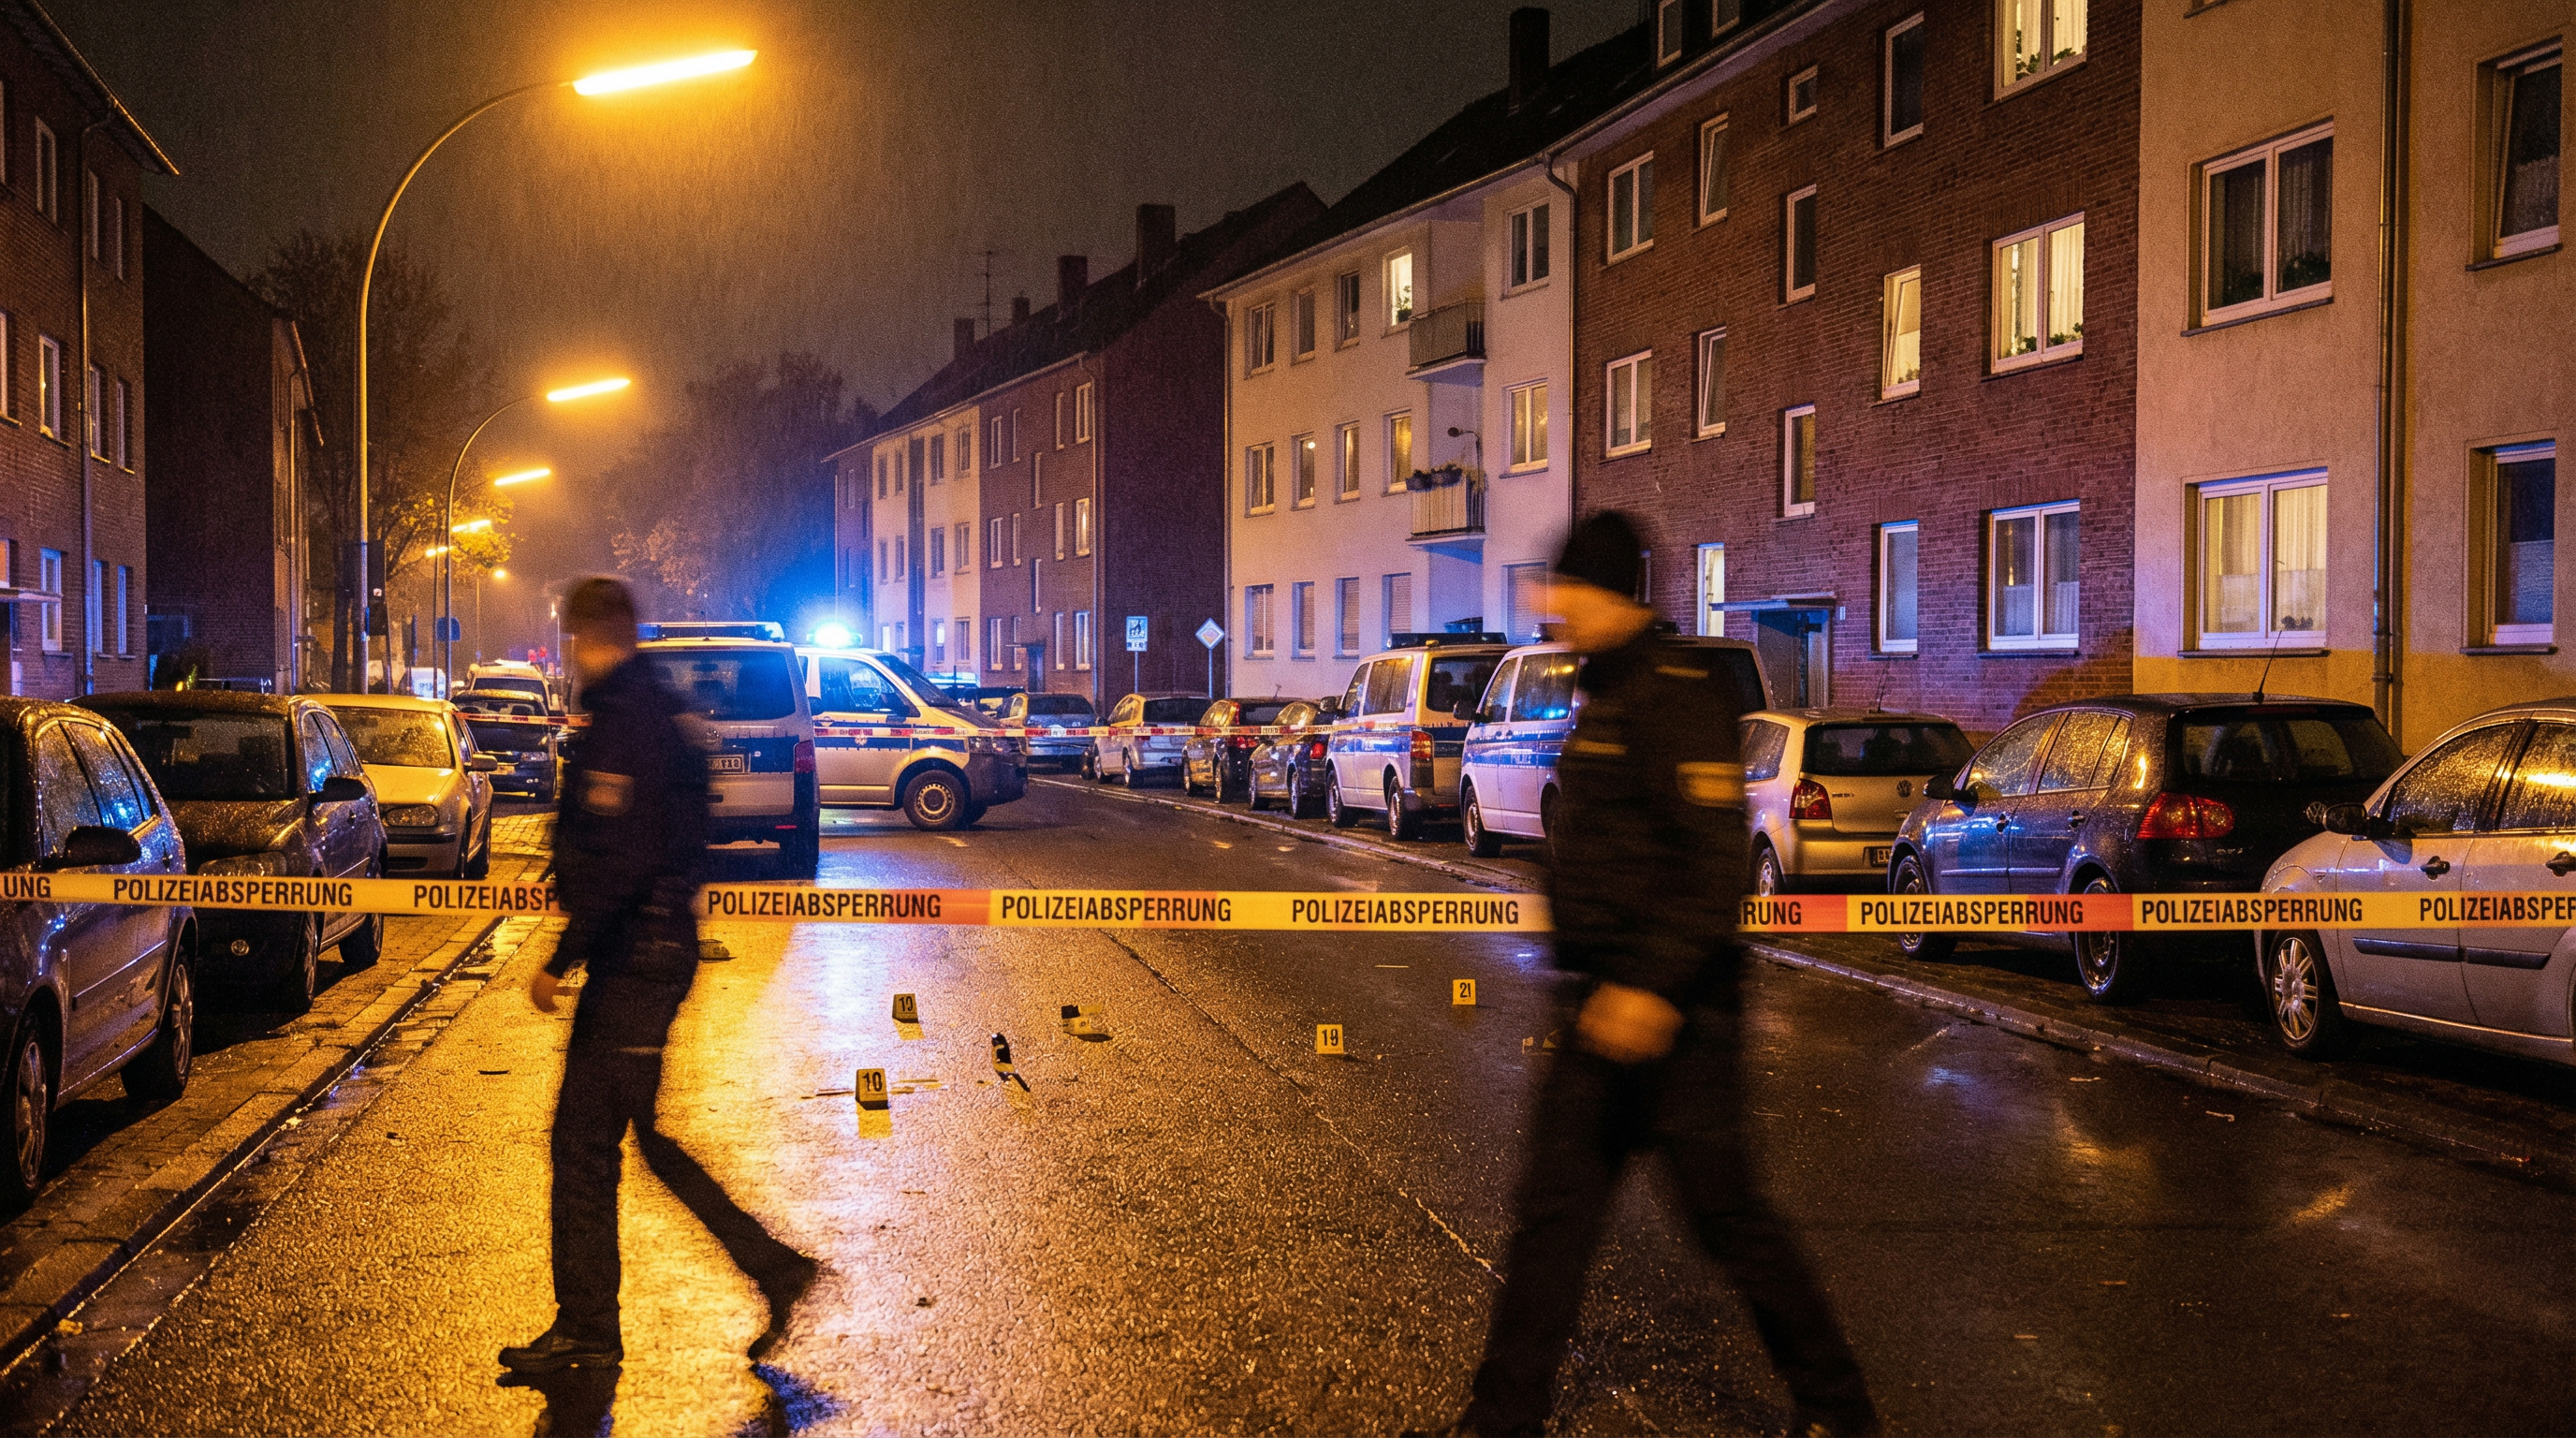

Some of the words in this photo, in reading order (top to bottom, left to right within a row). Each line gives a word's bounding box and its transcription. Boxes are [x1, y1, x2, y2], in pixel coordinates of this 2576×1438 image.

[4, 875, 51, 898] UNG
[113, 878, 353, 907] POLIZEIABSPERRUNG
[708, 890, 942, 918] POLIZEIABSPERRUNG
[1002, 895, 1232, 922] POLIZEIABSPERRUNG
[1292, 899, 1518, 925] POLIZEIABSPERRUNG
[1861, 901, 2084, 925] POLIZEIABSPERRUNG
[2142, 899, 2363, 924] POLIZEIABSPERRUNG
[1459, 981, 1471, 998] 21
[862, 1071, 883, 1093] 10
